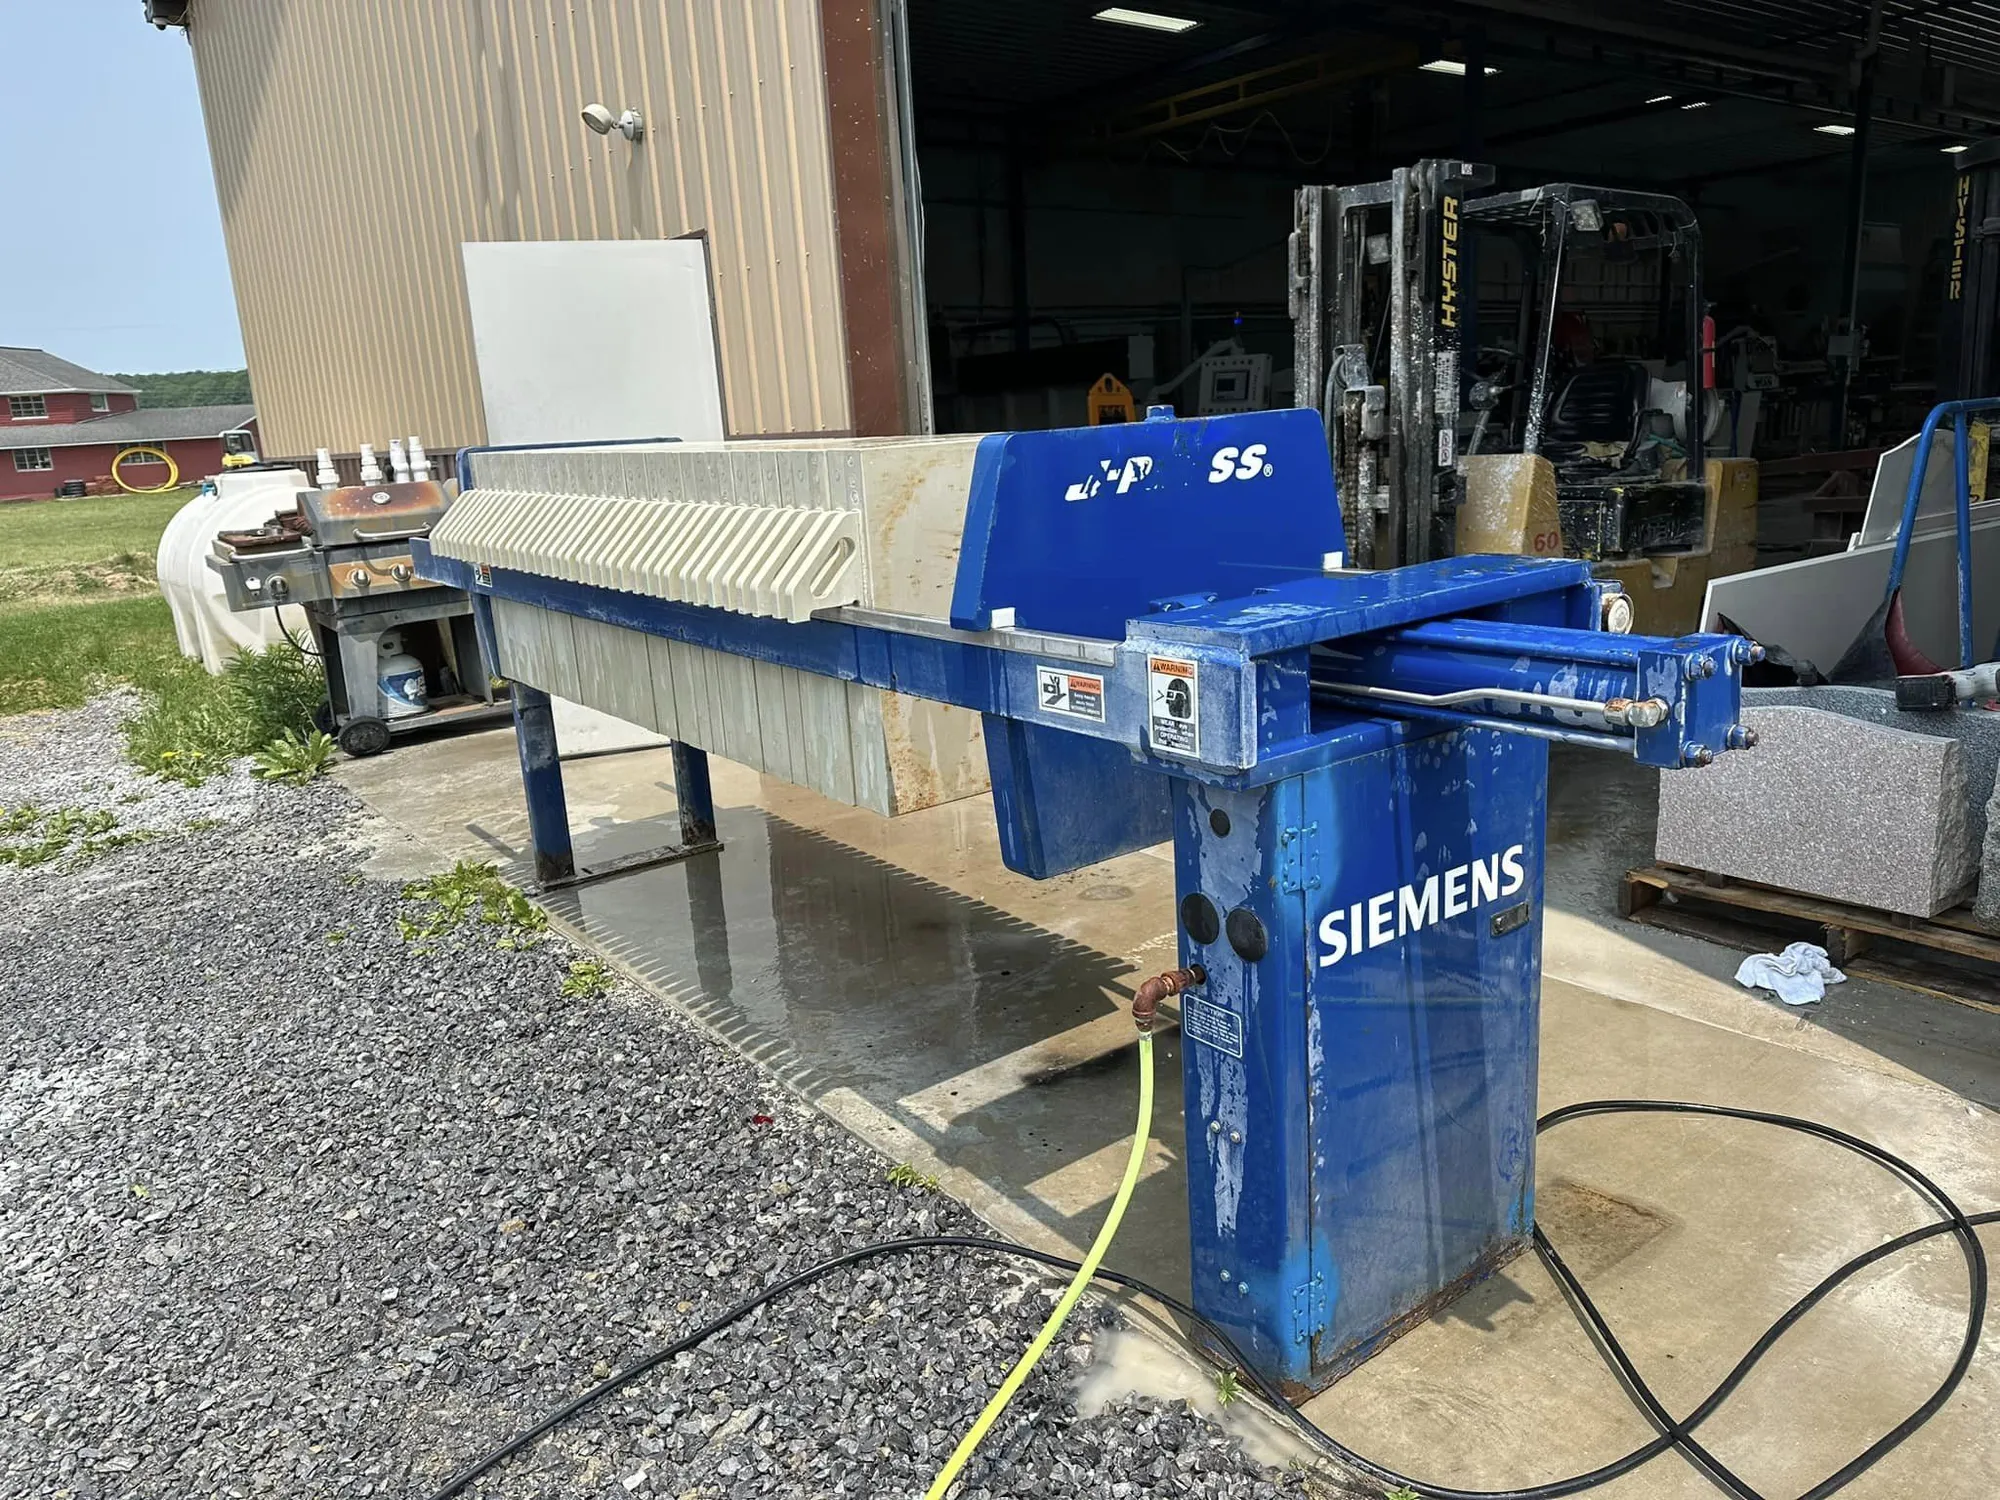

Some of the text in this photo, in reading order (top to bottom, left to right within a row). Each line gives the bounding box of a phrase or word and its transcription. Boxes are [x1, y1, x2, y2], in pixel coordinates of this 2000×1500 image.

[1441, 195, 1459, 328] HYSTER
[1949, 175, 1970, 300] HYSTER
[1533, 531, 1560, 552] 60
[1318, 844, 1525, 968] SIEMENS
